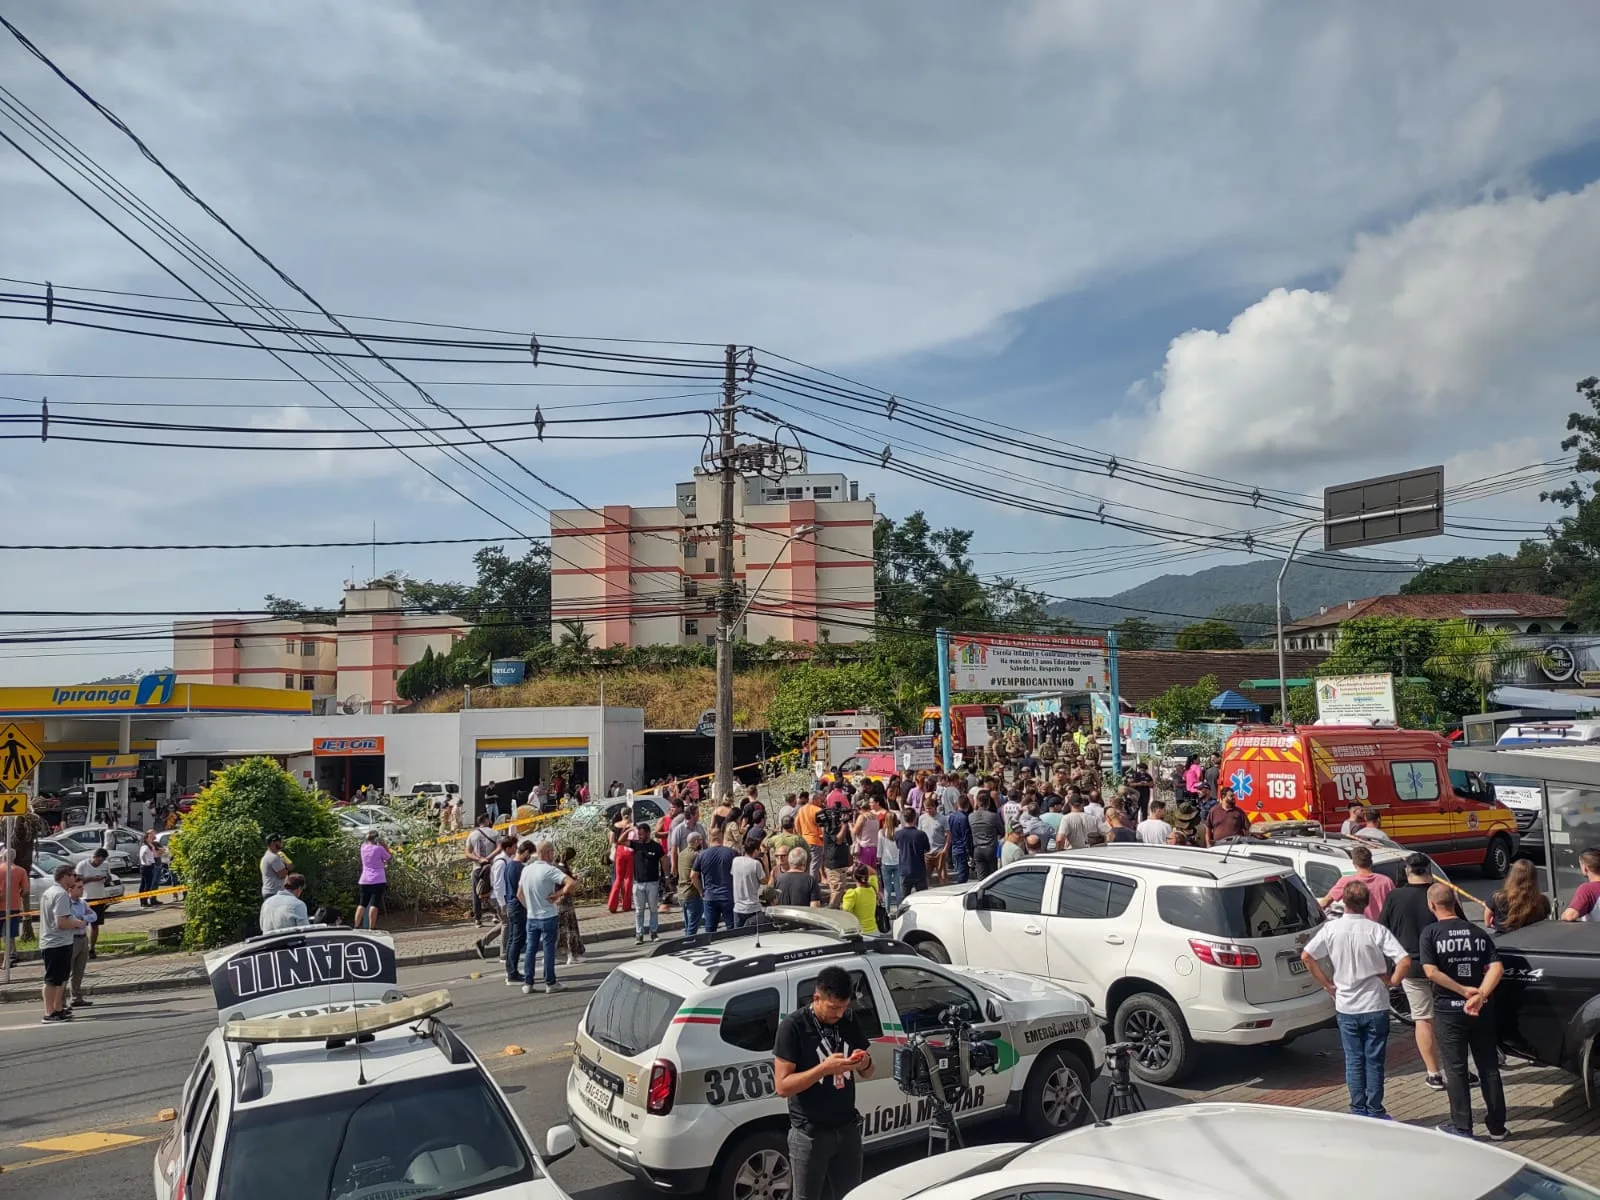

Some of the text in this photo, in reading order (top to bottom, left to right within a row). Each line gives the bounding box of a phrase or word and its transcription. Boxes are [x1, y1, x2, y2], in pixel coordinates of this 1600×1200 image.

[991, 677, 1074, 687] #VEMPROCANTINHO
[52, 687, 131, 705] Ipiranga
[317, 738, 377, 750] JET OIL
[1231, 736, 1293, 748] BOMBEIROS
[1332, 745, 1376, 757] BOMBEIROS
[1266, 780, 1296, 799] 193
[1332, 773, 1368, 800] 193
[783, 949, 824, 960] DUSTER
[1436, 938, 1486, 954] NOTA 10
[228, 942, 382, 996] CANIL
[704, 1061, 775, 1106] 3283
[864, 1085, 985, 1137] LÍCIA MTAR
